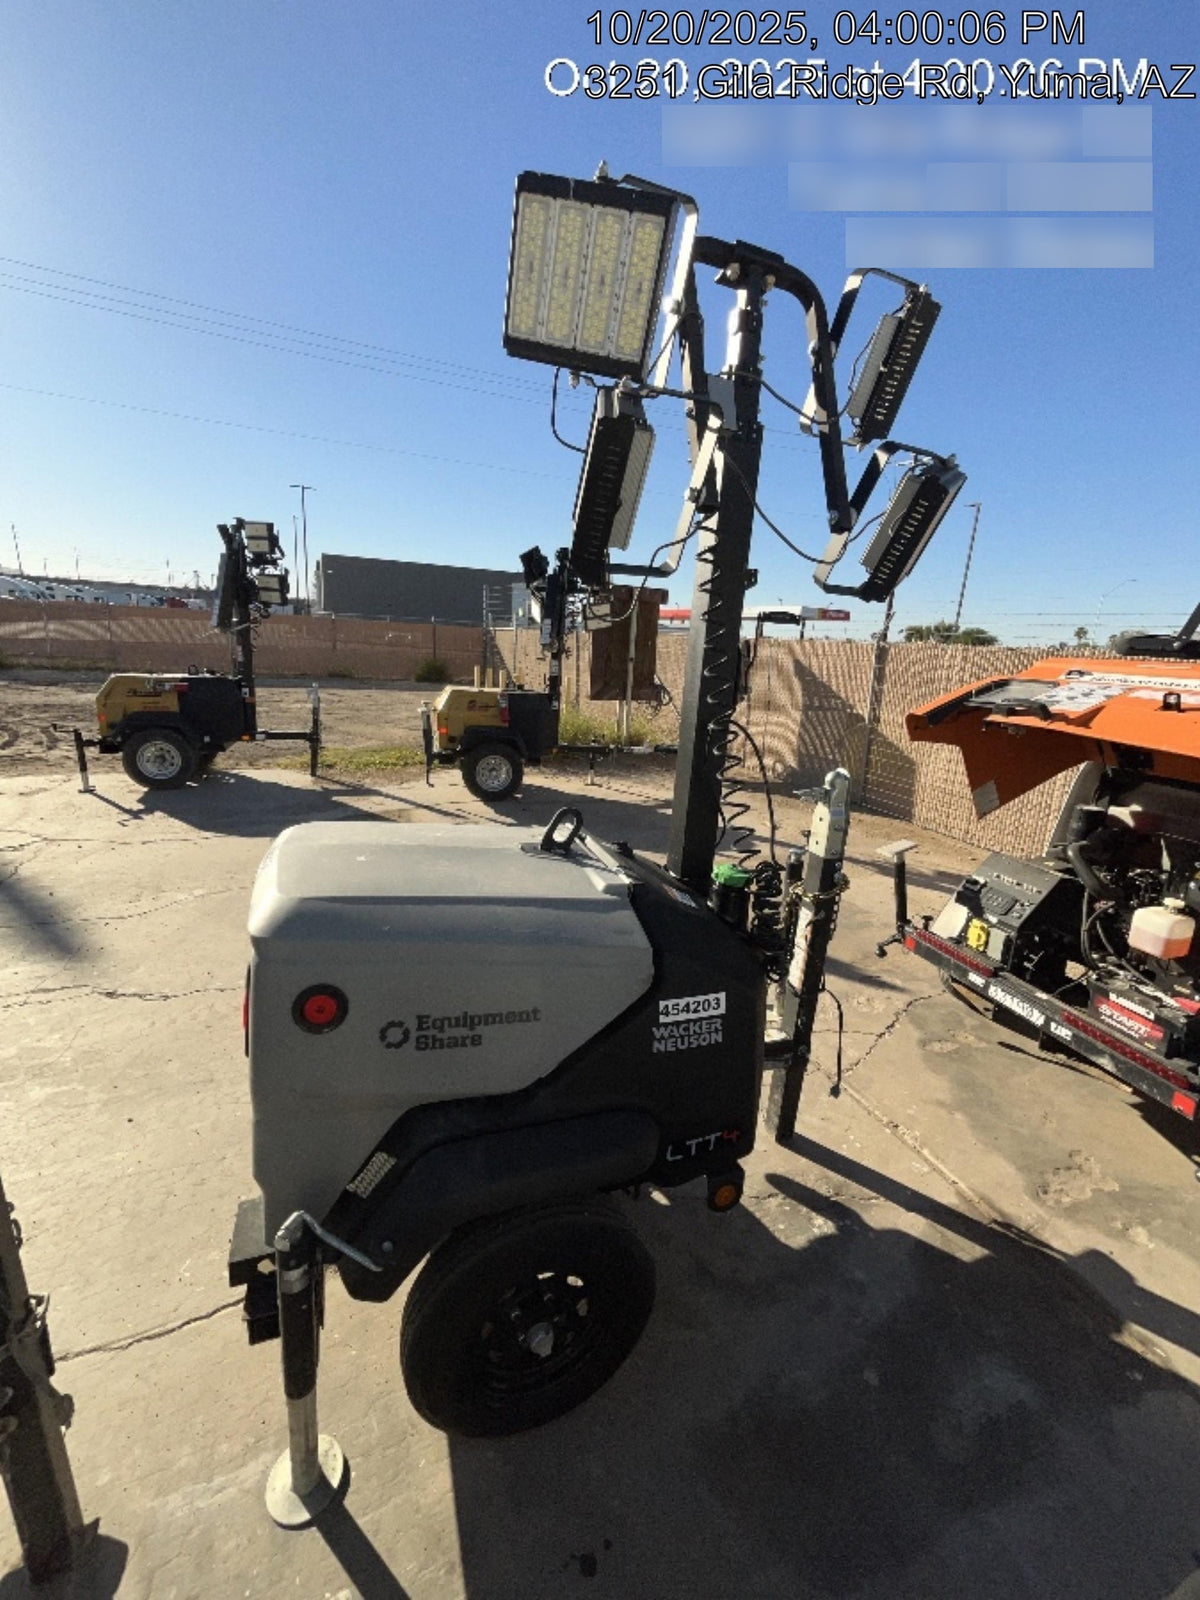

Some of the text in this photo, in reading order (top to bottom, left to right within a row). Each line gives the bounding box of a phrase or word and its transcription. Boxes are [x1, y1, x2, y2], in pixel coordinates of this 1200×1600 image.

[661, 997, 721, 1017] 454203
[416, 1006, 542, 1033] Equipment
[652, 1018, 722, 1039] WACKER
[415, 1034, 483, 1051] Share
[652, 1031, 723, 1053] NEUSON
